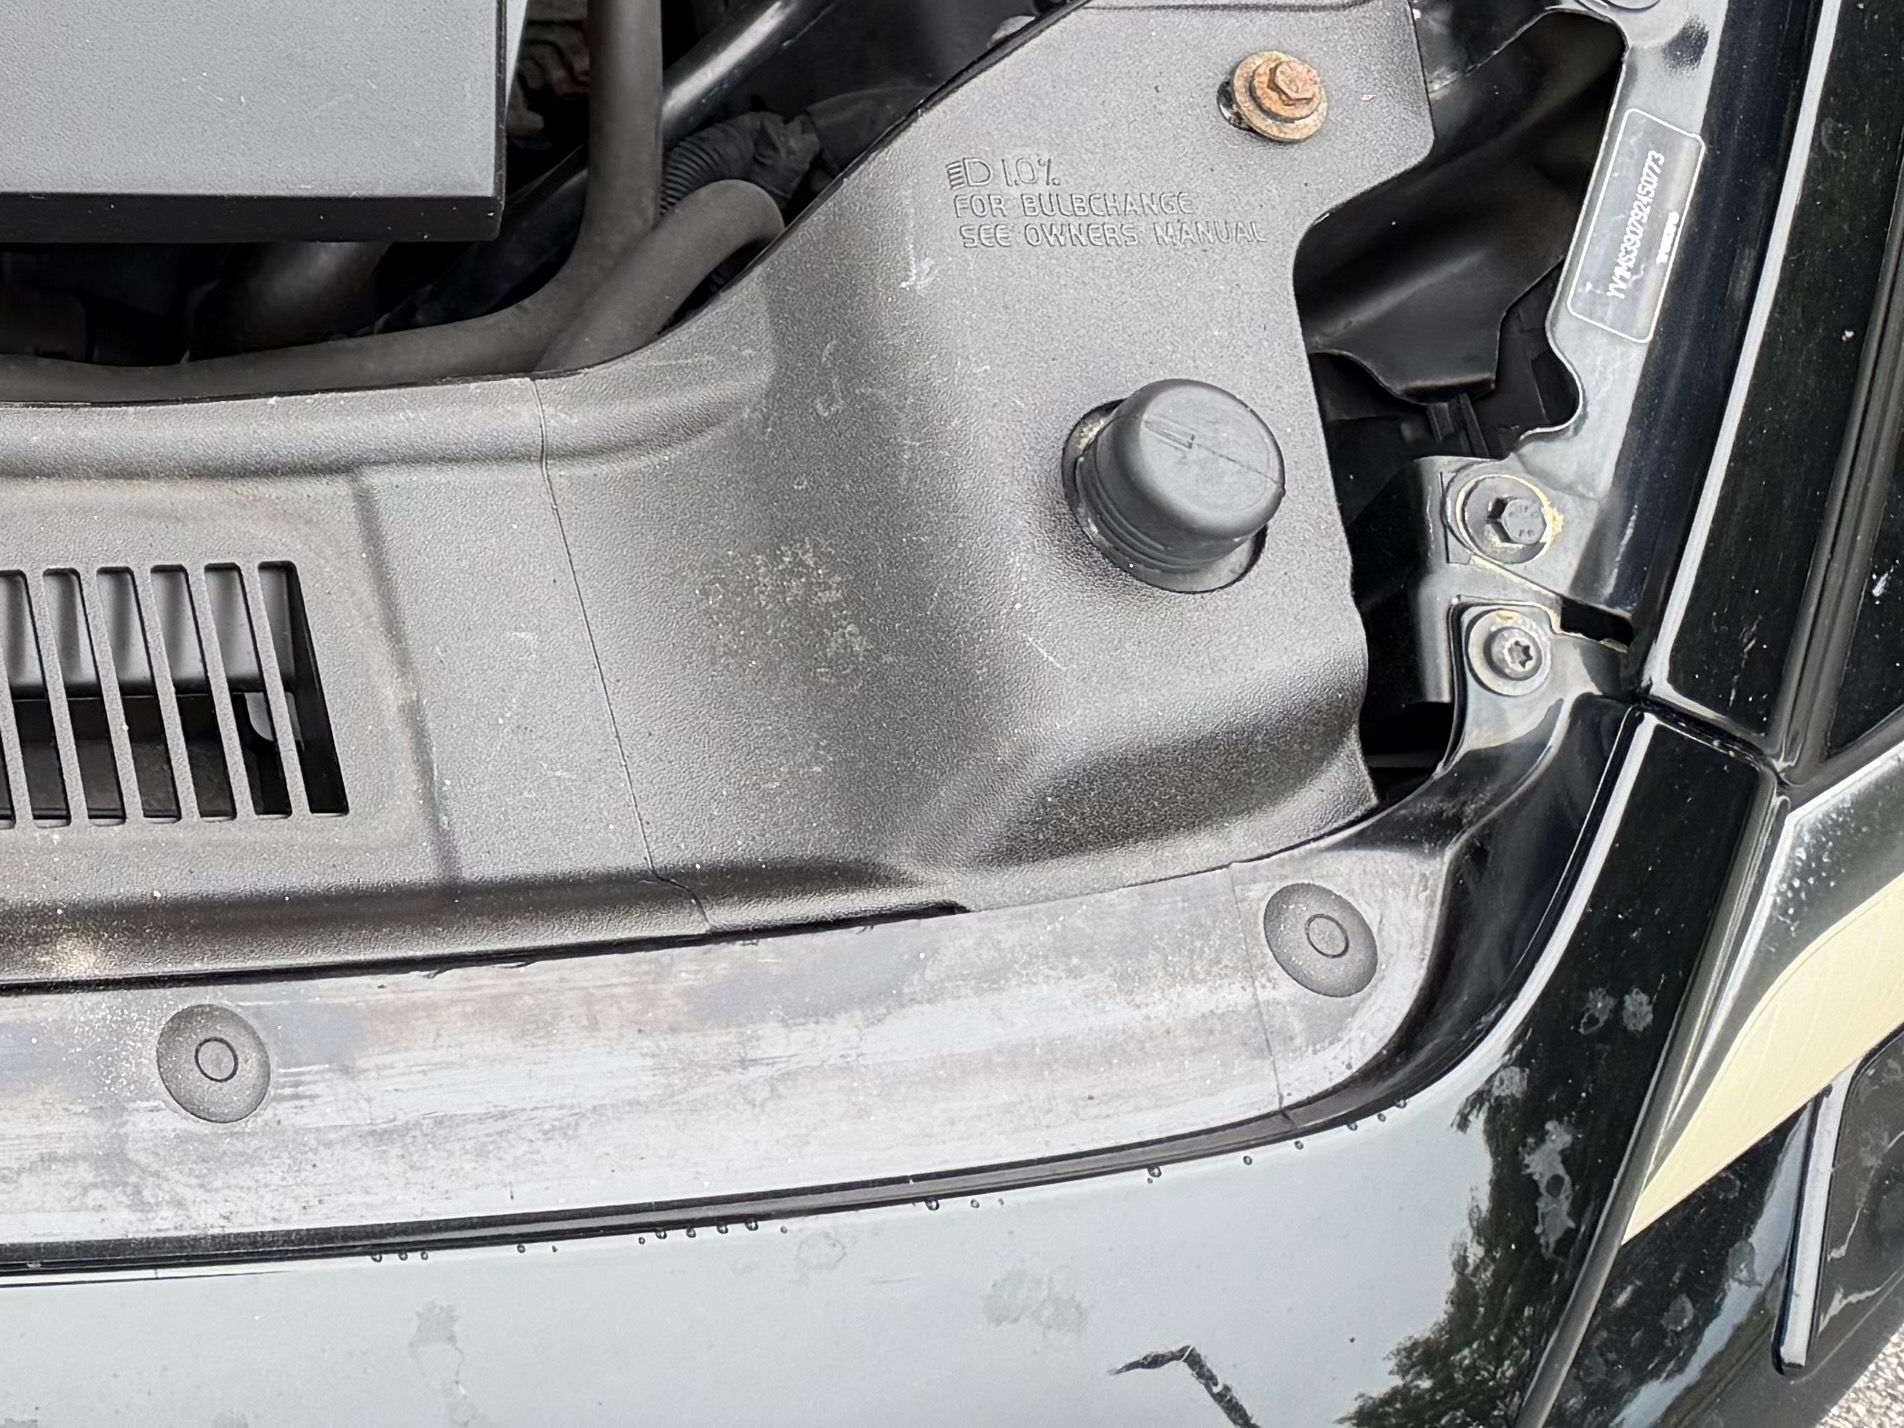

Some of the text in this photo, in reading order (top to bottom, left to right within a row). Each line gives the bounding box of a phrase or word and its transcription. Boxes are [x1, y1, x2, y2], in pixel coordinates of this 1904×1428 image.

[953, 189, 1193, 219] FOR BULBCHANGE
[960, 217, 1266, 249] SEE OWNERS MANUAL
